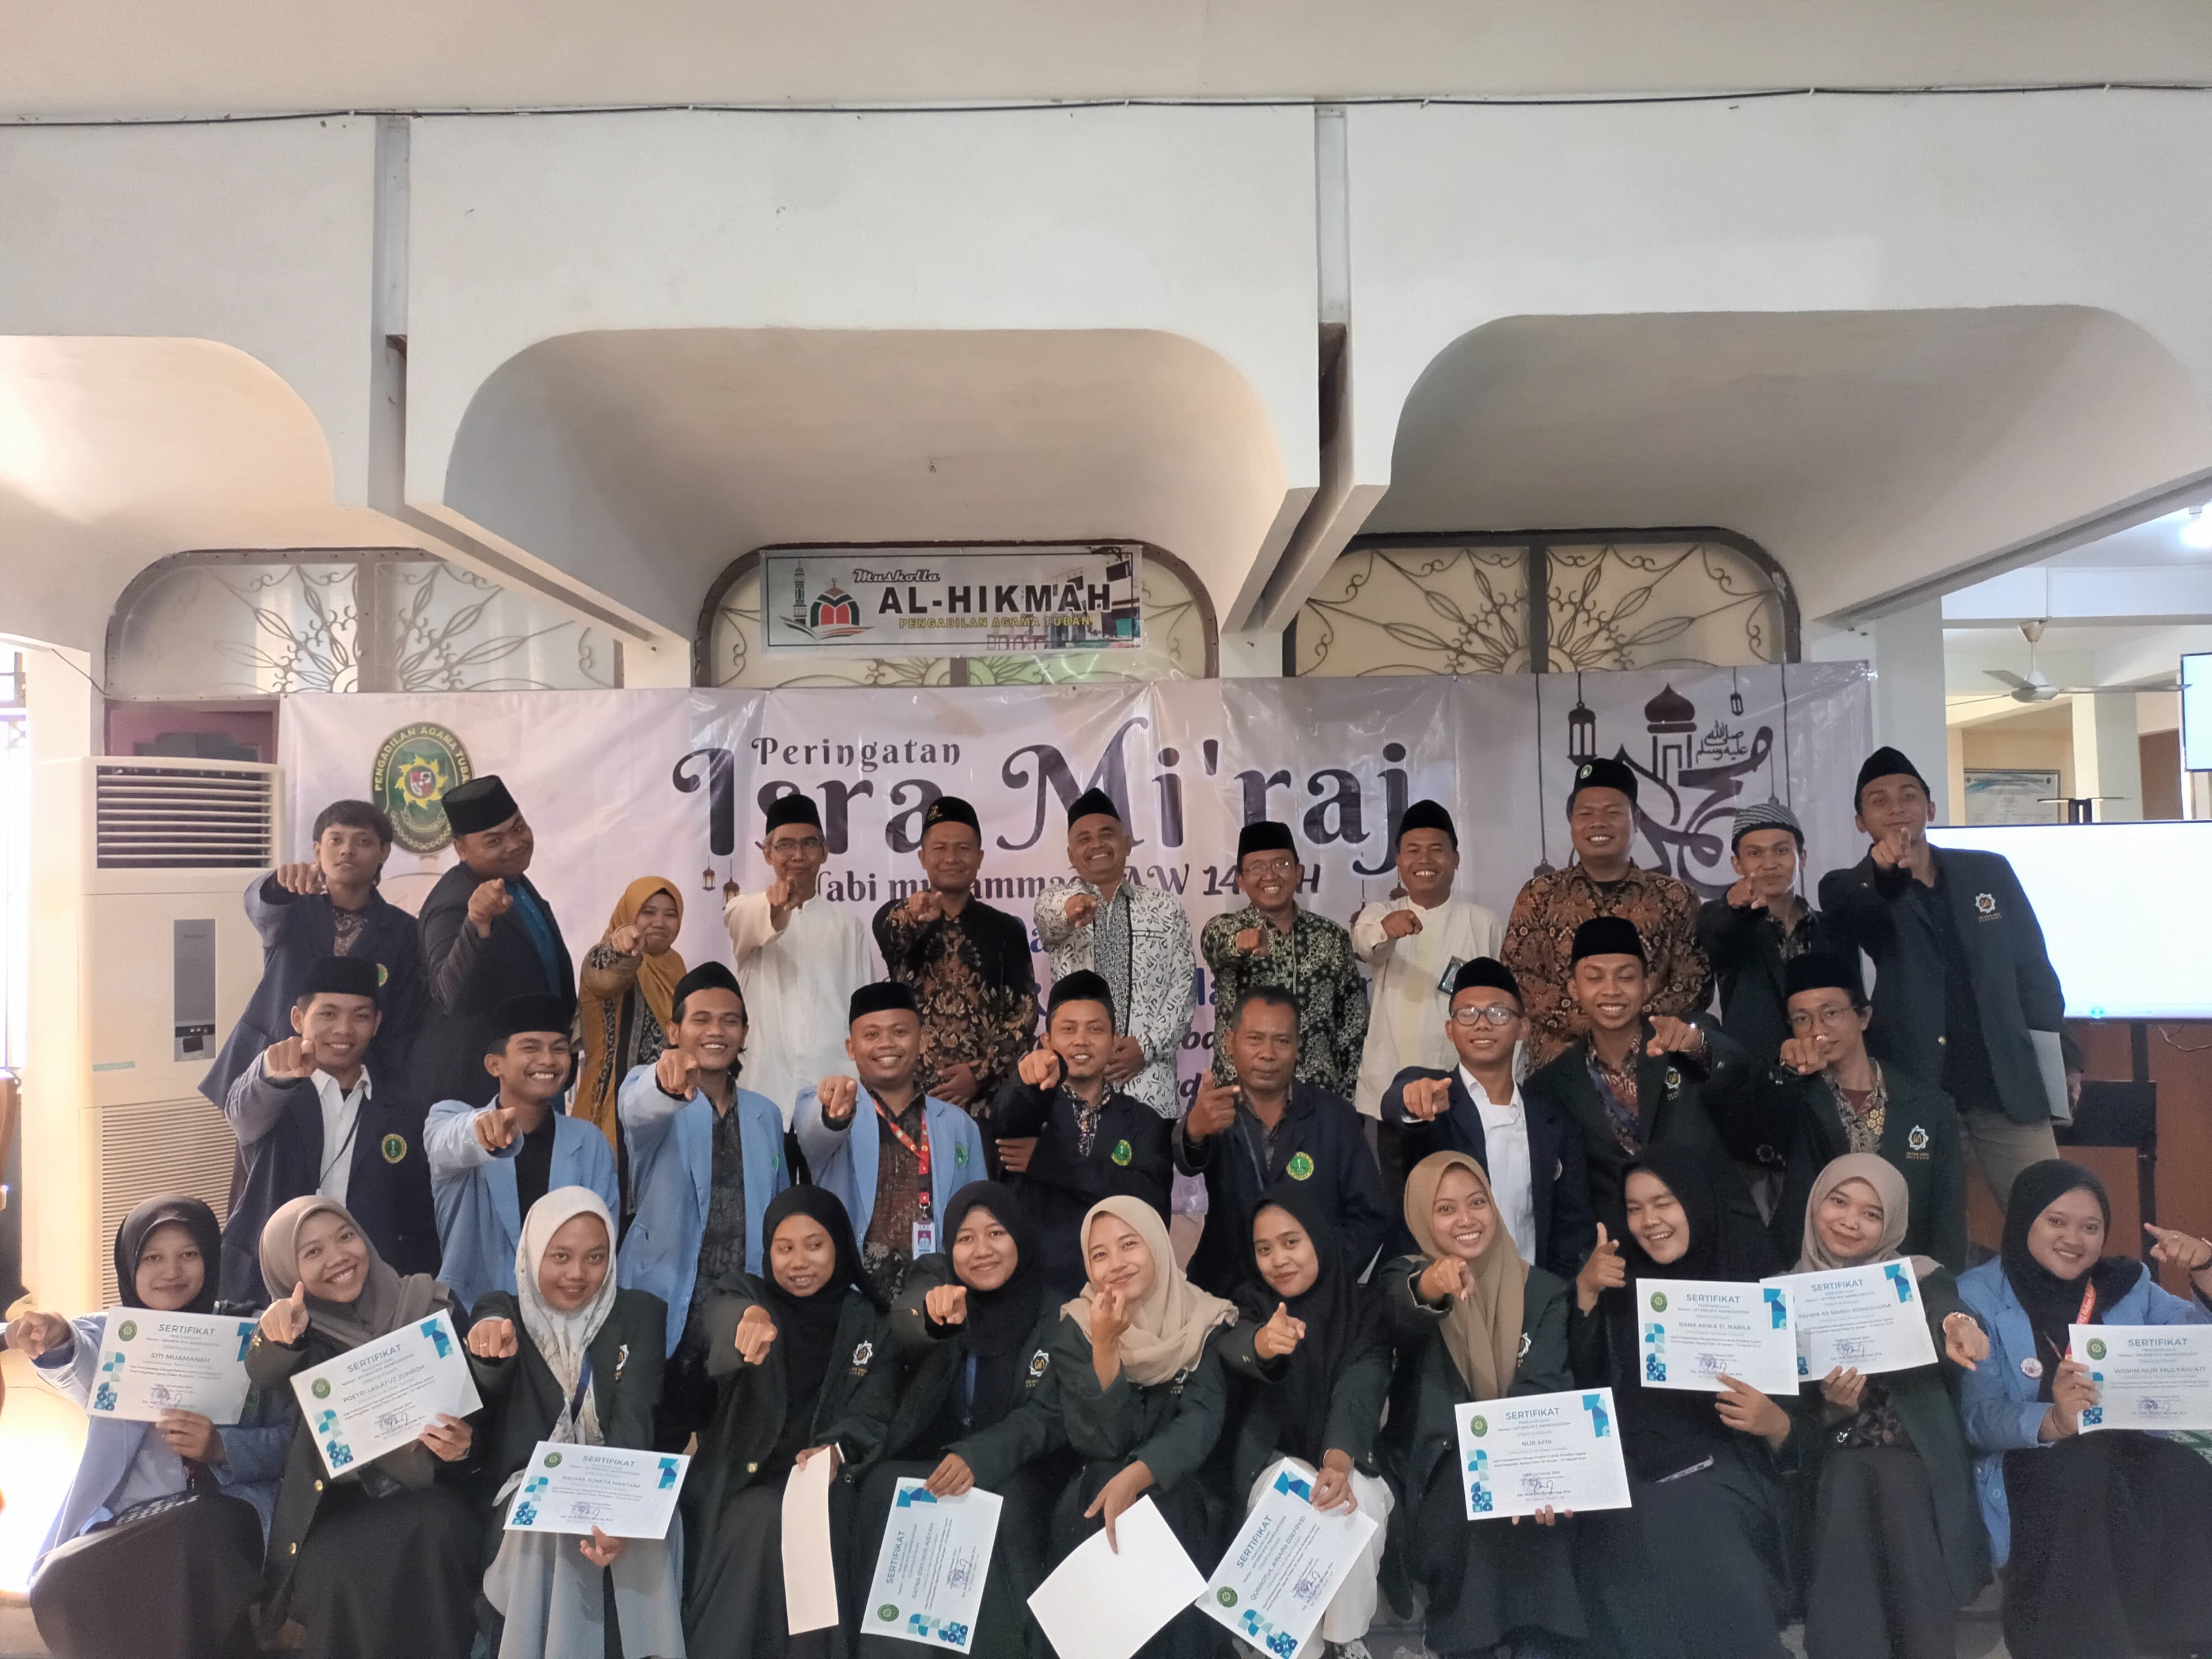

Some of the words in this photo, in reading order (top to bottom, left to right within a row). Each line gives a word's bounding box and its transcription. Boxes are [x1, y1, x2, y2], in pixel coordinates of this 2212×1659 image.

[853, 569, 940, 583] Musholla
[878, 584, 1111, 615] AL-HIKMAH
[899, 617, 988, 629] PENGADILAN
[991, 616, 1040, 627] AGAMA
[1044, 615, 1090, 627] TUBAN
[374, 727, 416, 791] PENGADILAN
[419, 726, 456, 751] AGAMA
[455, 750, 471, 784] TUBA
[751, 737, 961, 772] Peringatan
[996, 717, 1408, 876] Mi'raj
[1686, 1293, 1740, 1303] SERTIFIKAT
[1811, 1279, 1863, 1291] SERTIFIKAT
[158, 1323, 215, 1336] SERTIFIKAT
[347, 1344, 402, 1372] SERTIFIKAT
[343, 1389, 366, 1403] POETRI
[398, 1365, 425, 1379] ZUHROH
[1506, 1407, 1559, 1419] SERTIFIKAT
[582, 1455, 635, 1467] SERTIFIKAT
[1236, 1514, 1272, 1569] SERTIFIKAT
[885, 1530, 906, 1584] SERTIFIKAT
